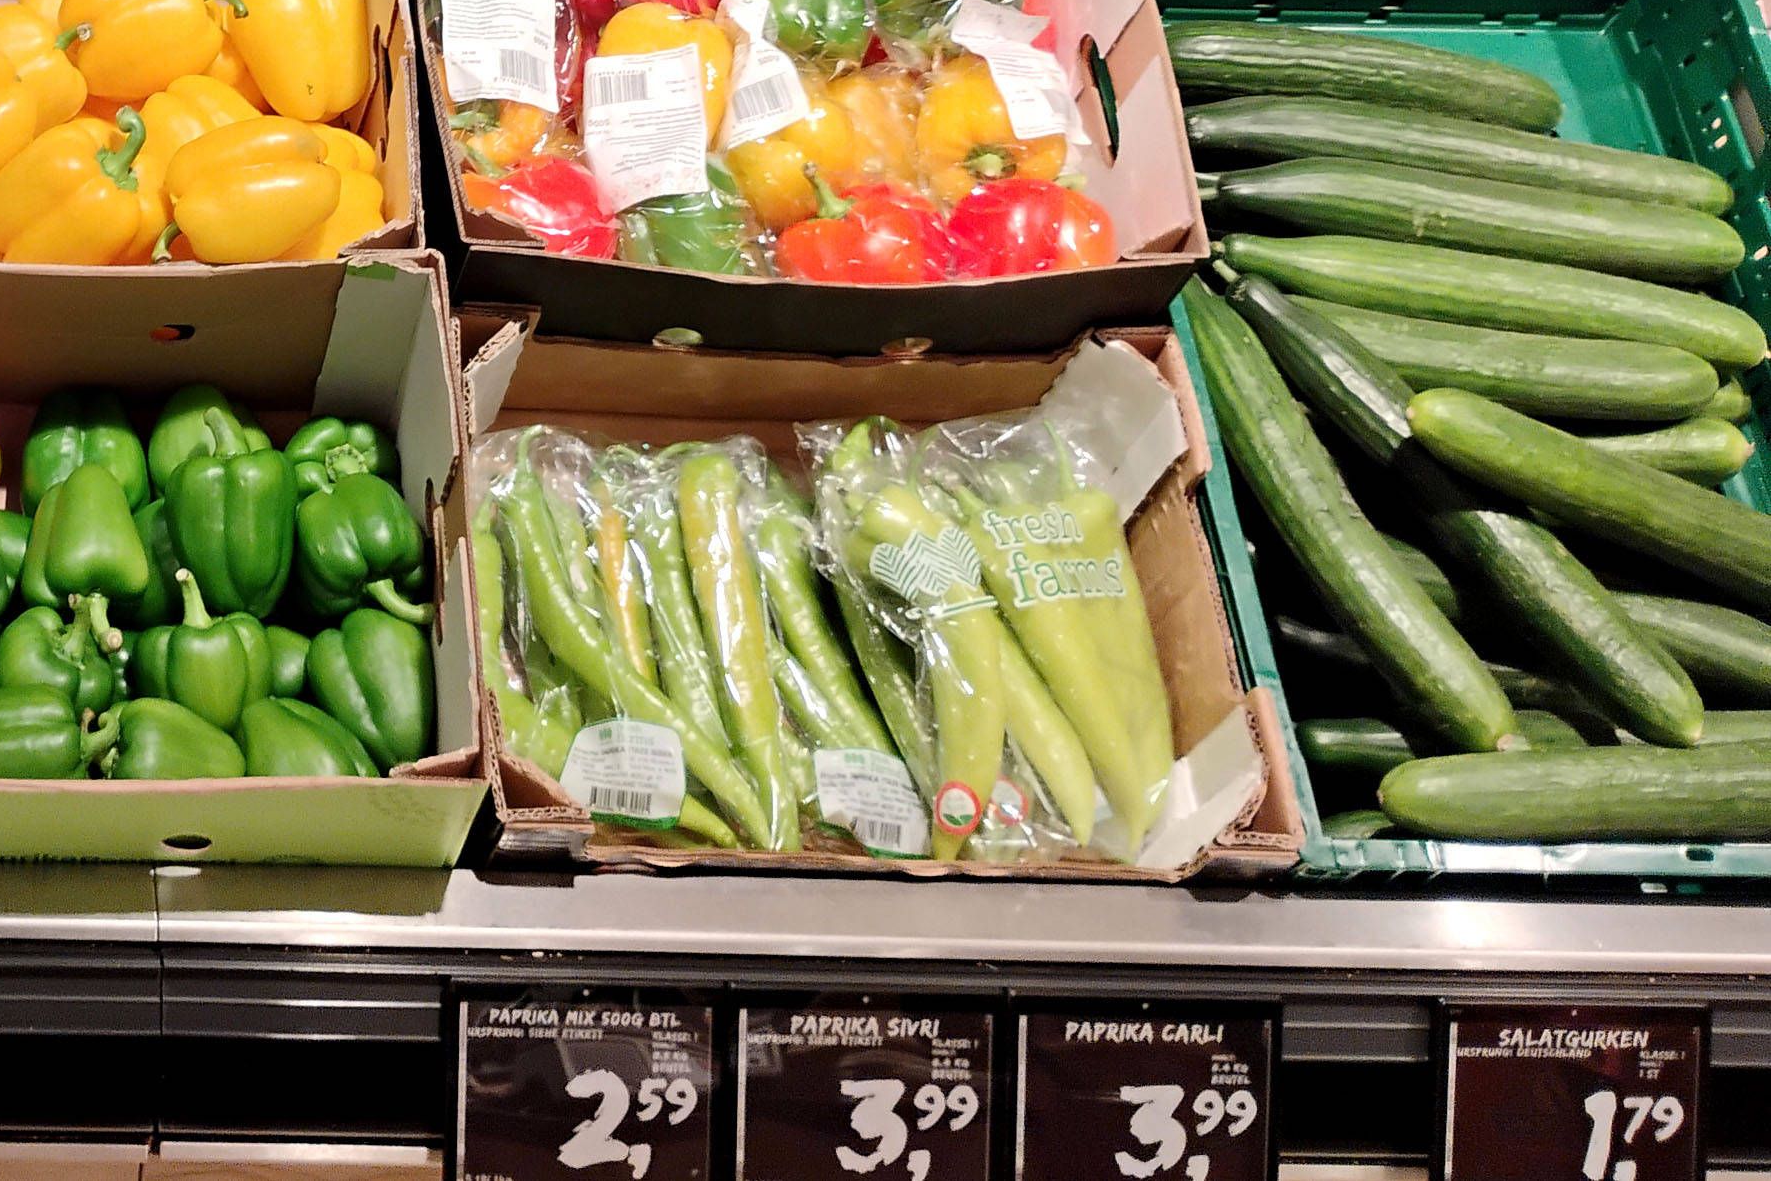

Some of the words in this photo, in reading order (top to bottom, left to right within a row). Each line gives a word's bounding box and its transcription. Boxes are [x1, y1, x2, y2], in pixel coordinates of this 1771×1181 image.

[982, 502, 1084, 549] fresh
[1006, 549, 1126, 607] farms
[489, 1007, 560, 1026] PAPRIKA
[565, 1009, 596, 1026] MIX
[601, 1011, 645, 1028] 500G
[649, 1012, 681, 1028] BTL
[790, 1014, 879, 1036] PAPRIKA
[887, 1017, 940, 1038] SIVRI
[1065, 1020, 1154, 1044] PAPRIKA
[1498, 1027, 1650, 1050] SALATGURKEN
[1516, 1047, 1592, 1059] DEUTSCHLAND
